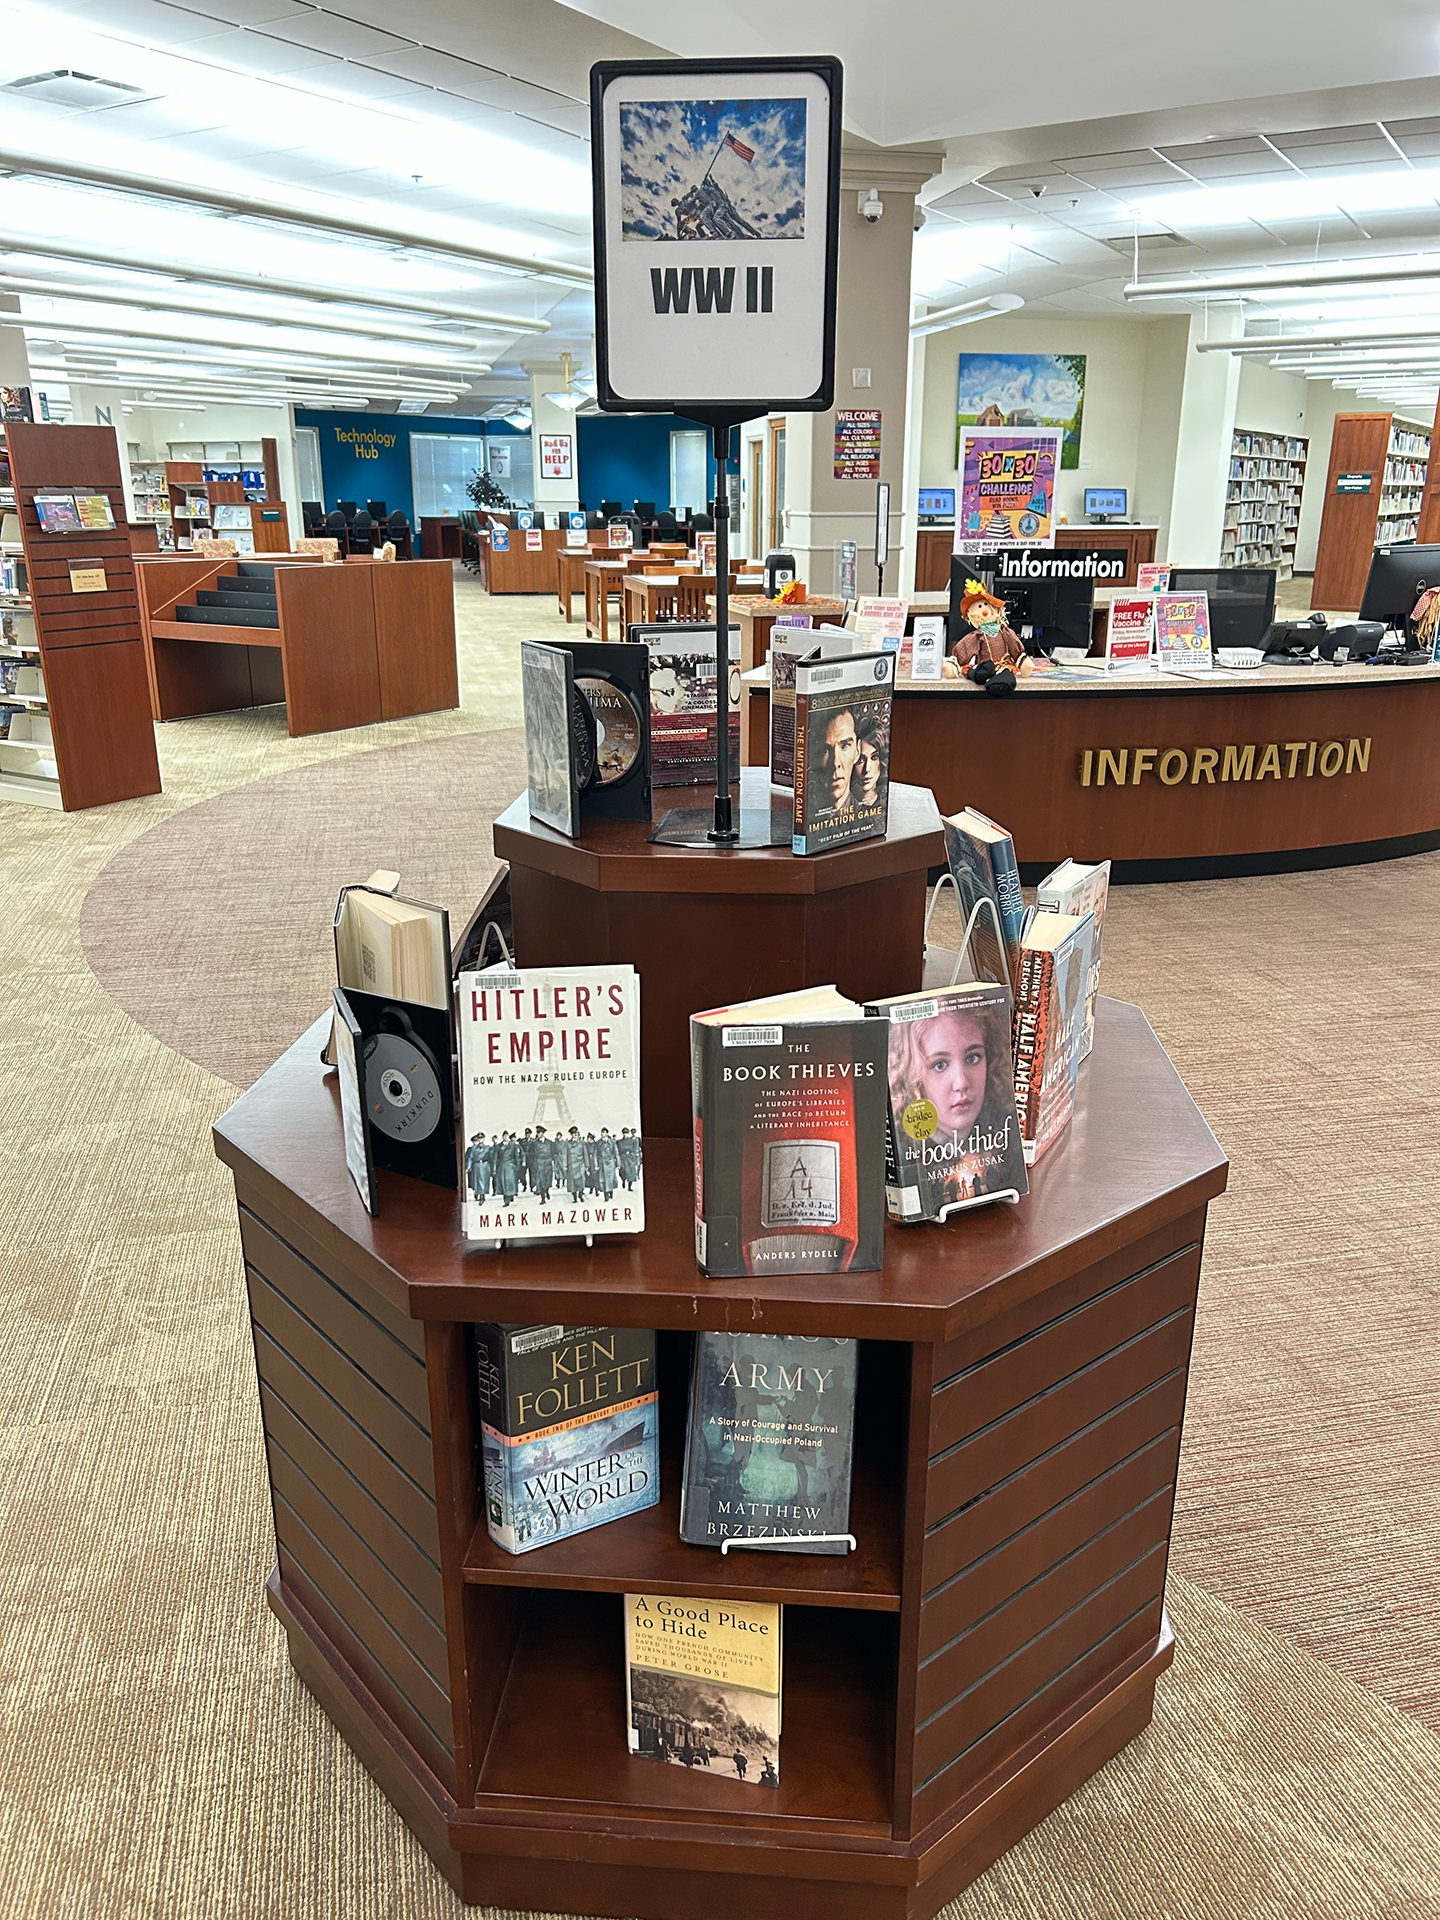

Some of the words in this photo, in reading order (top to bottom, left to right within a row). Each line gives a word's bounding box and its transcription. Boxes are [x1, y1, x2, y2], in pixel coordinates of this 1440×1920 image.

[650, 267, 735, 314] WW
[746, 267, 773, 313] II
[96, 406, 112, 425] N
[837, 412, 878, 421] WELCOME
[335, 428, 396, 447] Technology
[355, 444, 378, 459] Hub
[545, 455, 568, 464] HELP
[980, 483, 1032, 495] CHALLENGE
[1002, 550, 1124, 577] Information
[1114, 612, 1132, 620] FREE
[1134, 611, 1144, 619] Flu
[796, 747, 804, 795] IMITATION
[1081, 737, 1371, 786] INFORMATION
[795, 797, 803, 824] GAME
[809, 814, 855, 832] IMITATION
[858, 806, 882, 819] GAME
[840, 805, 854, 815] THE
[996, 873, 1013, 917] MORRIS
[1007, 869, 1023, 914] HEATHER
[1019, 960, 1031, 1001] DELMONT
[1031, 957, 1043, 1000] MATTHEW
[472, 984, 624, 1022] HITLER'S
[958, 1002, 978, 1010] TWENTIETH
[1019, 1013, 1037, 1055] HALF
[1054, 1014, 1075, 1051] HALF
[488, 1028, 612, 1064] EMPIRE
[788, 1044, 810, 1052] THE
[723, 1065, 780, 1081] BOOK
[788, 1062, 874, 1079] THIEVES
[1040, 1033, 1081, 1096] AMERICAN
[473, 1076, 494, 1085] HOW
[499, 1075, 516, 1084] THE
[521, 1073, 549, 1083] NAZIS
[554, 1071, 585, 1081] RULED
[590, 1070, 627, 1080] EUROPE
[395, 1091, 434, 1133] DUNKIRK
[797, 1120, 849, 1128] INHERITANCE
[906, 1111, 932, 1123] bridge
[906, 1147, 921, 1161] the
[922, 1129, 966, 1166] book
[968, 1115, 1012, 1155] thief
[915, 1128, 931, 1139] clay
[790, 1156, 806, 1178] A
[927, 1162, 968, 1181] MARKUS
[971, 1154, 1005, 1169] ZUSAK
[819, 1201, 834, 1210] Jud.
[480, 1212, 529, 1228] MARK
[542, 1208, 633, 1225] MAZOWER
[756, 1252, 796, 1260] ANDERS
[802, 1250, 838, 1258] RYDELL
[540, 1340, 560, 1349] GIANTS
[551, 1334, 616, 1381] KEN
[477, 1341, 491, 1409] FOLLETT
[489, 1362, 501, 1400] KEN
[719, 1362, 833, 1394] ARMY
[516, 1358, 649, 1425] FOLLETT
[535, 1429, 550, 1438] BOOK
[552, 1425, 563, 1433] TWO
[575, 1418, 585, 1426] THE
[587, 1408, 609, 1421] CENTURY
[611, 1402, 633, 1413] TRILOGY
[718, 1417, 739, 1427] Story
[742, 1419, 749, 1427] of
[752, 1420, 785, 1431] Courage
[788, 1423, 802, 1431] and
[804, 1424, 838, 1433] Survival
[734, 1433, 792, 1446] Nazi-Occupied
[794, 1438, 822, 1447] Poland
[625, 1450, 636, 1460] OF
[628, 1456, 644, 1468] THE
[524, 1453, 626, 1500] WINTER
[546, 1470, 649, 1520] WORLD
[718, 1501, 820, 1520] MATTHEW
[635, 1597, 649, 1611] A
[657, 1601, 710, 1623] Good
[718, 1612, 769, 1635] Place
[635, 1615, 653, 1628] to
[661, 1618, 707, 1639] Hide
[635, 1639, 660, 1647] SAVED
[663, 1645, 713, 1658] THOUSANDS
[730, 1658, 754, 1666] LIVES
[635, 1645, 668, 1655] DURING
[670, 1652, 698, 1661] WORLD
[701, 1658, 718, 1666] WAR
[677, 1641, 709, 1650] FRENCH
[712, 1647, 764, 1662] COMMUNITY
[636, 1654, 677, 1667] PETER
[685, 1664, 729, 1678] GROSE
